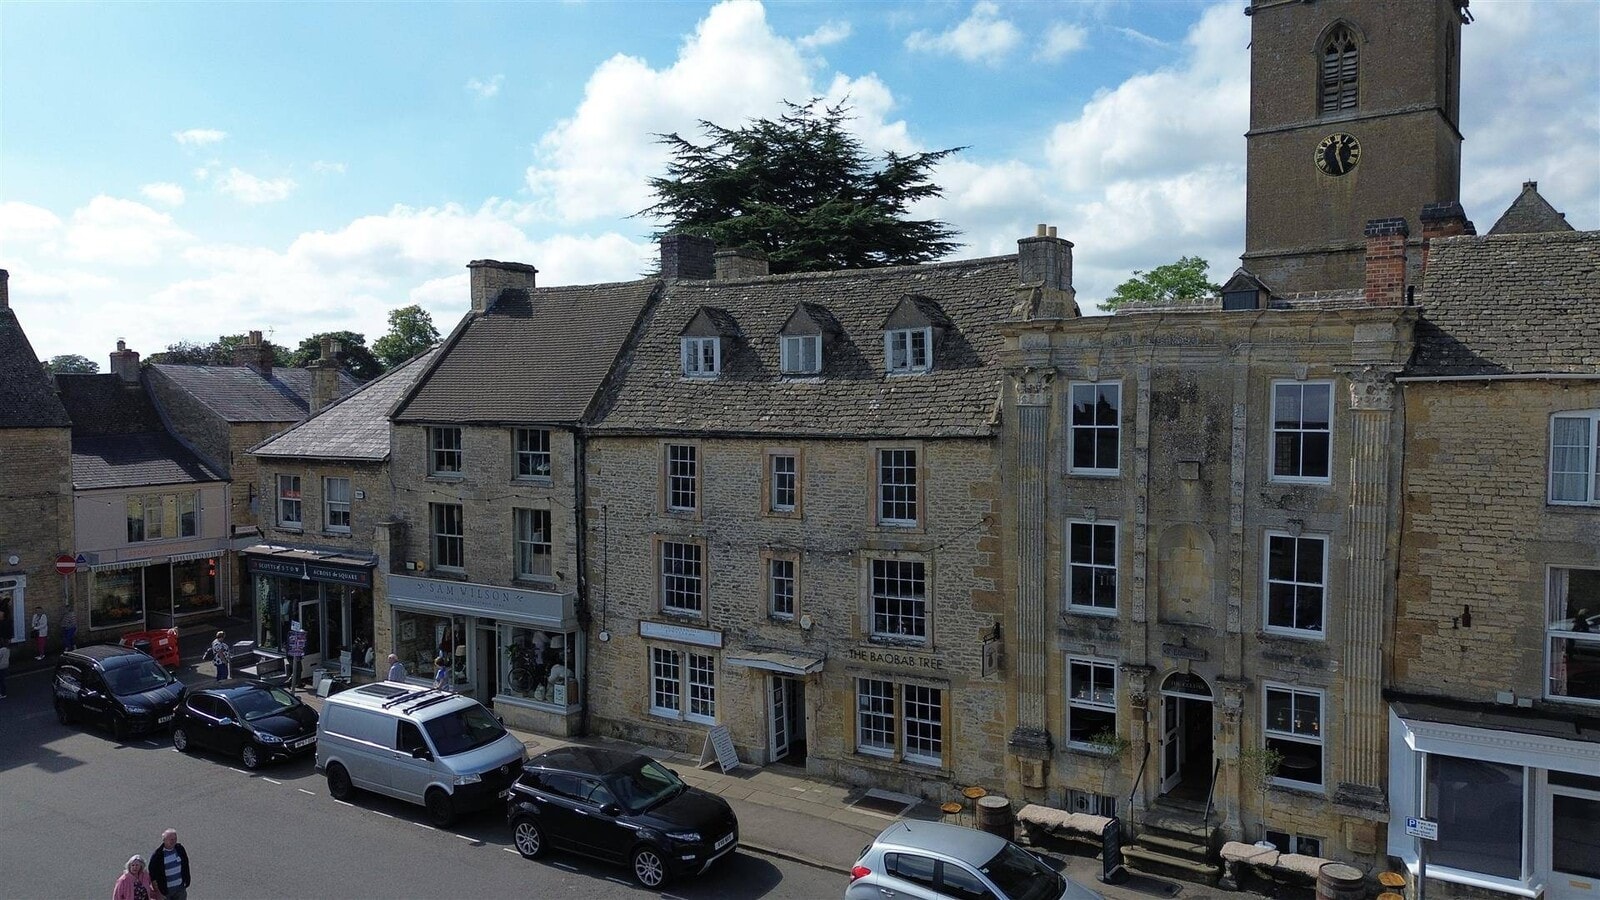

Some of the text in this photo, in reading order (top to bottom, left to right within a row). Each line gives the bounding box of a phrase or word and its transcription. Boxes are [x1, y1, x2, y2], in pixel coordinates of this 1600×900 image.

[429, 583, 453, 595] SAM
[459, 586, 509, 602] WILSON
[849, 649, 943, 670] THE BAOBAB TREE
